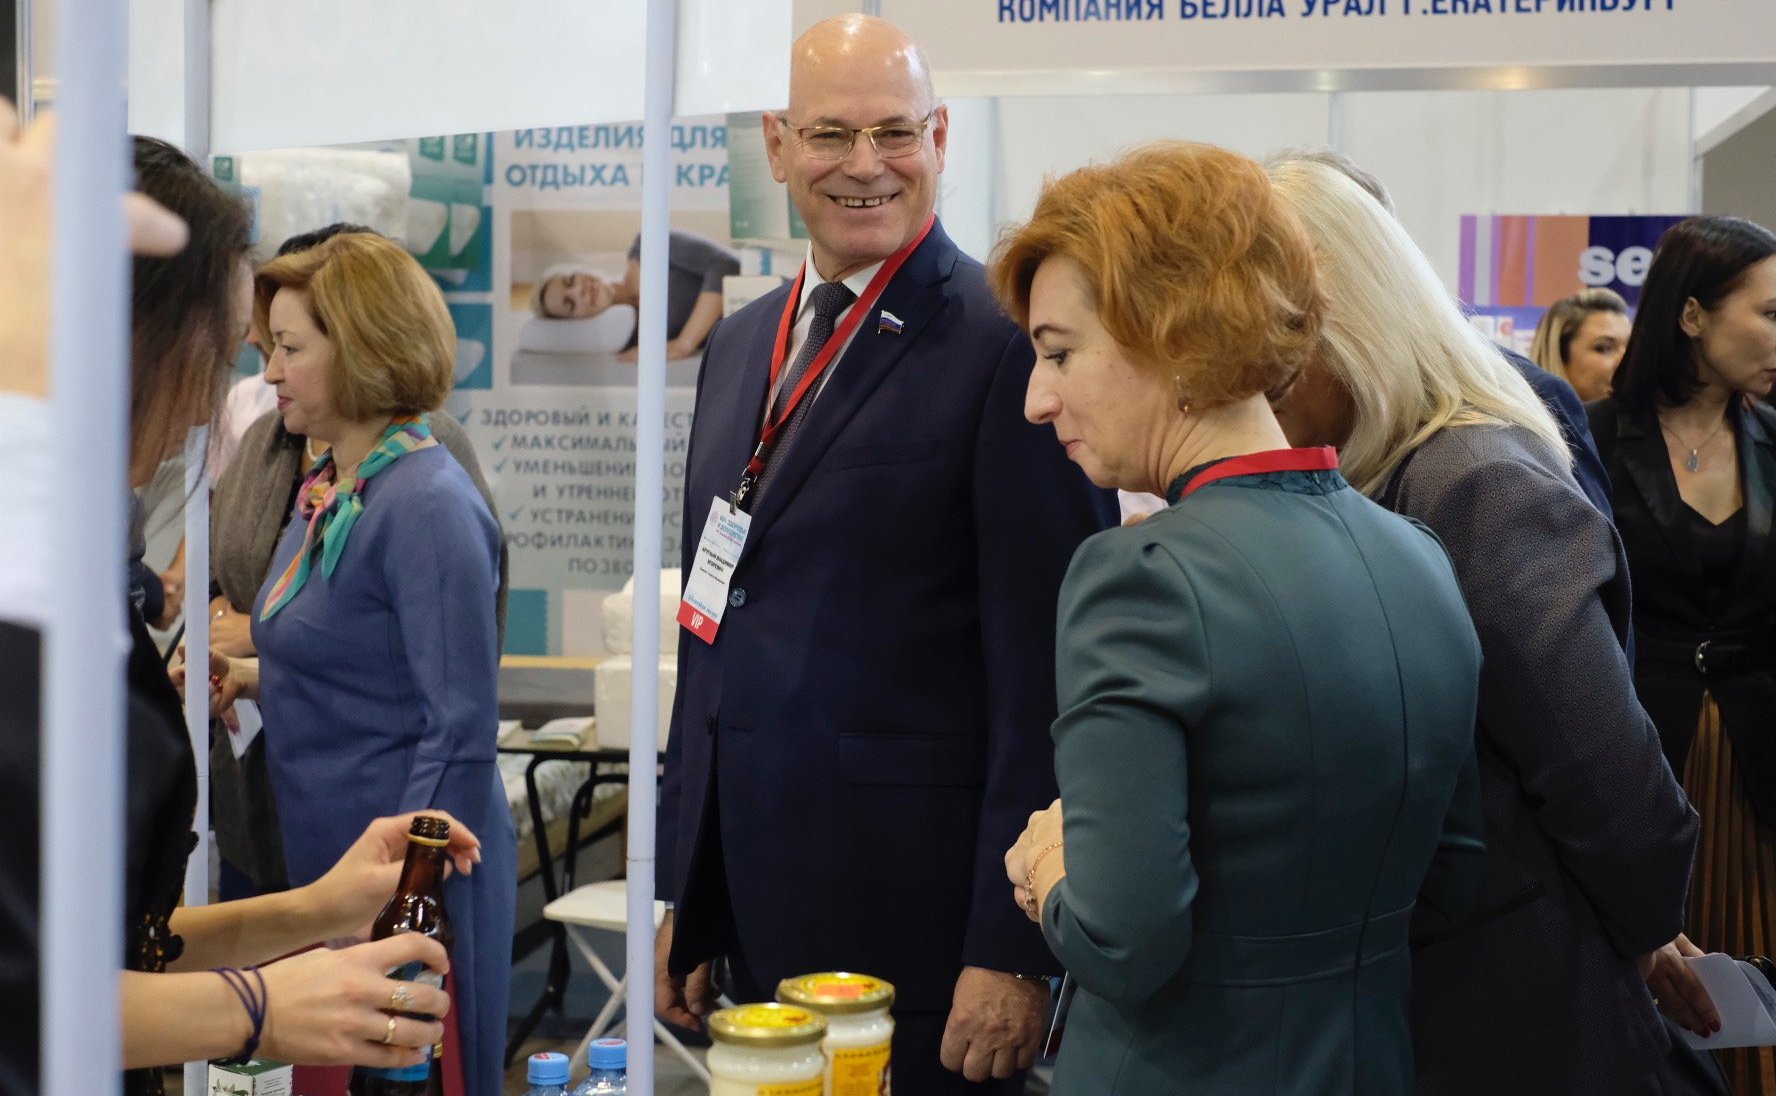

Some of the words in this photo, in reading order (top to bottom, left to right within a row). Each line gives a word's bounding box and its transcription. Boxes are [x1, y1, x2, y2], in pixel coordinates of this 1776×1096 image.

[998, 0, 1164, 23] КОМПАНИЯ
[1180, 0, 1286, 20] БЕЛЛА
[1301, 0, 1386, 17] УРАЛ
[505, 163, 630, 190] ОТДЫХА
[480, 407, 590, 427] ЗДОРОВЫЙ
[597, 411, 610, 426] И
[510, 433, 686, 452] МАКСИМАЛЬЙ
[513, 459, 637, 477] УМЕНЬШЕНИ
[555, 485, 637, 500] УТРЕННЕ
[530, 507, 636, 524] УСТРАНЕНИ
[505, 531, 635, 550] РОФИЛАКТИ
[567, 557, 634, 575] ПОЗВО
[690, 612, 703, 630] VIP
